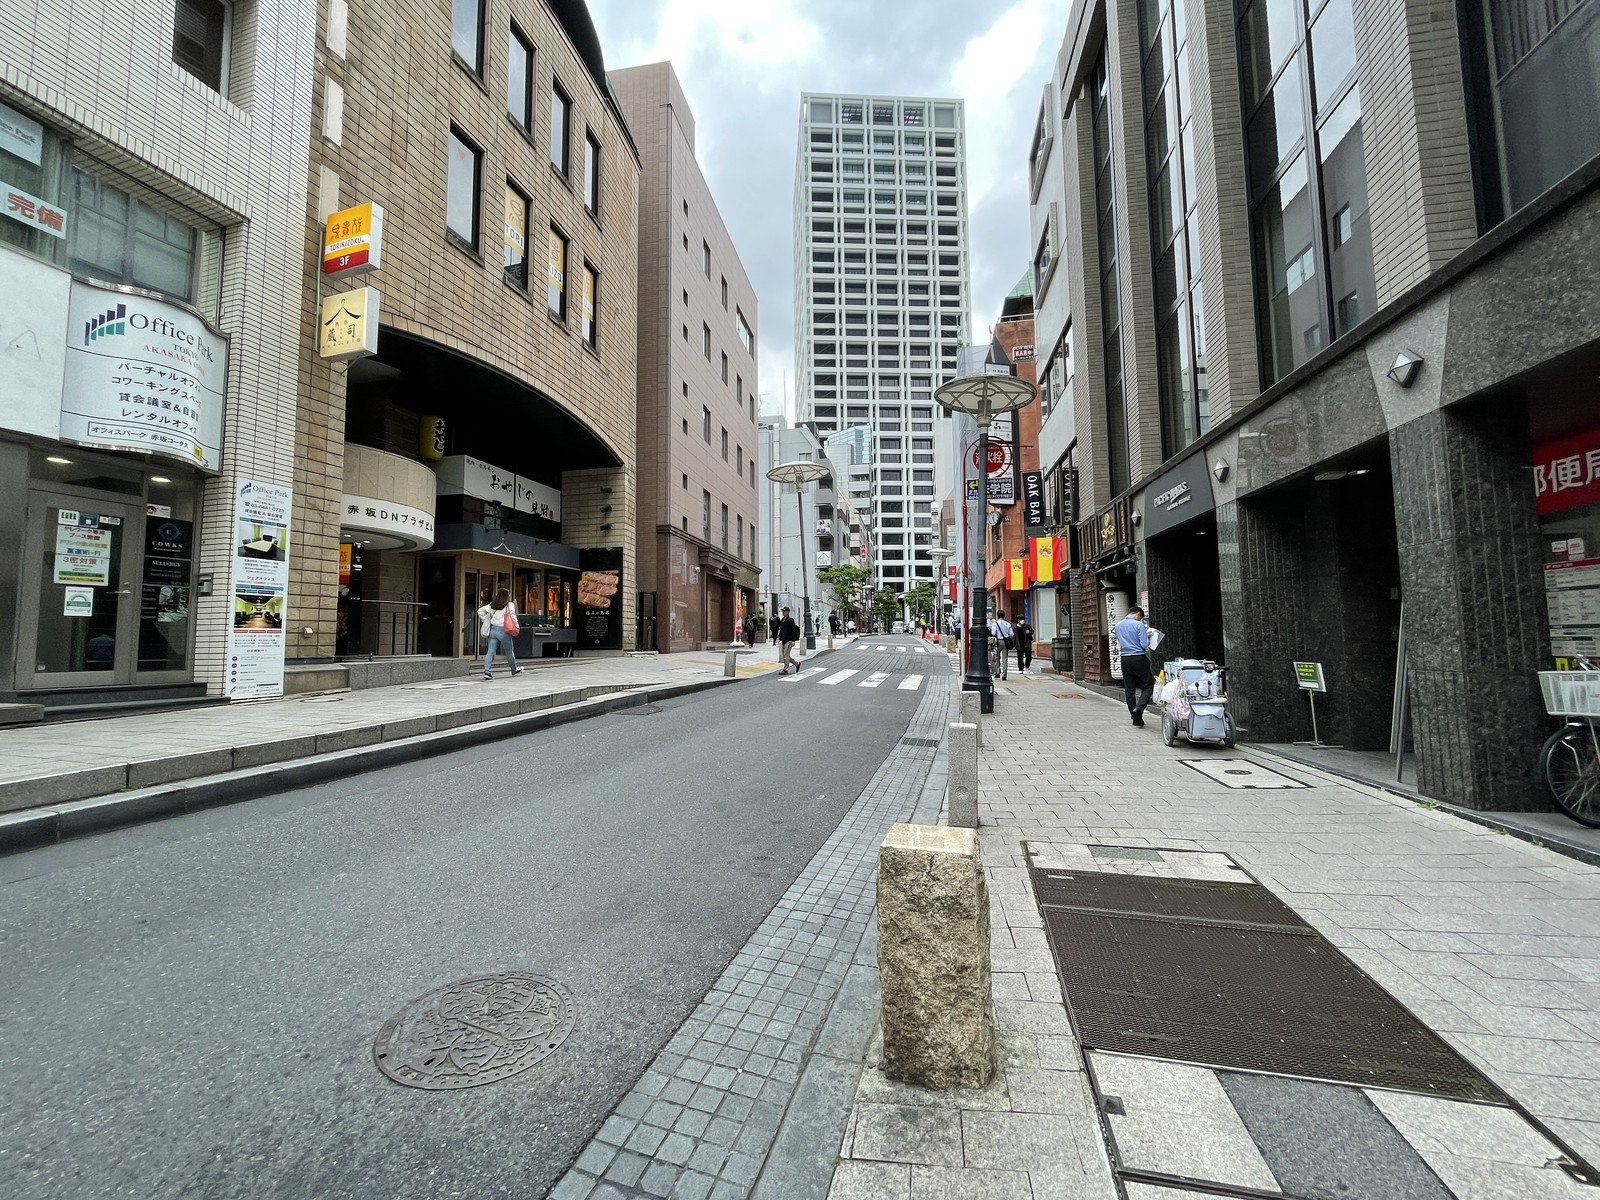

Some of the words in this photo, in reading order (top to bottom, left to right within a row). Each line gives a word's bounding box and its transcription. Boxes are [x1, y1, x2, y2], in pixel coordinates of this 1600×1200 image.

[8, 192, 63, 232] 完備
[330, 237, 361, 251] TORIKIZOKU
[505, 224, 524, 248] TORI
[339, 255, 350, 267] 3F
[129, 313, 194, 346] Office
[142, 344, 192, 366] AKASAKA
[172, 343, 200, 361] TOKYO
[252, 485, 274, 495] Office
[274, 489, 289, 498] Park
[1027, 475, 1040, 497] OAK
[1030, 501, 1041, 524] BAR
[151, 540, 183, 549] COWKS
